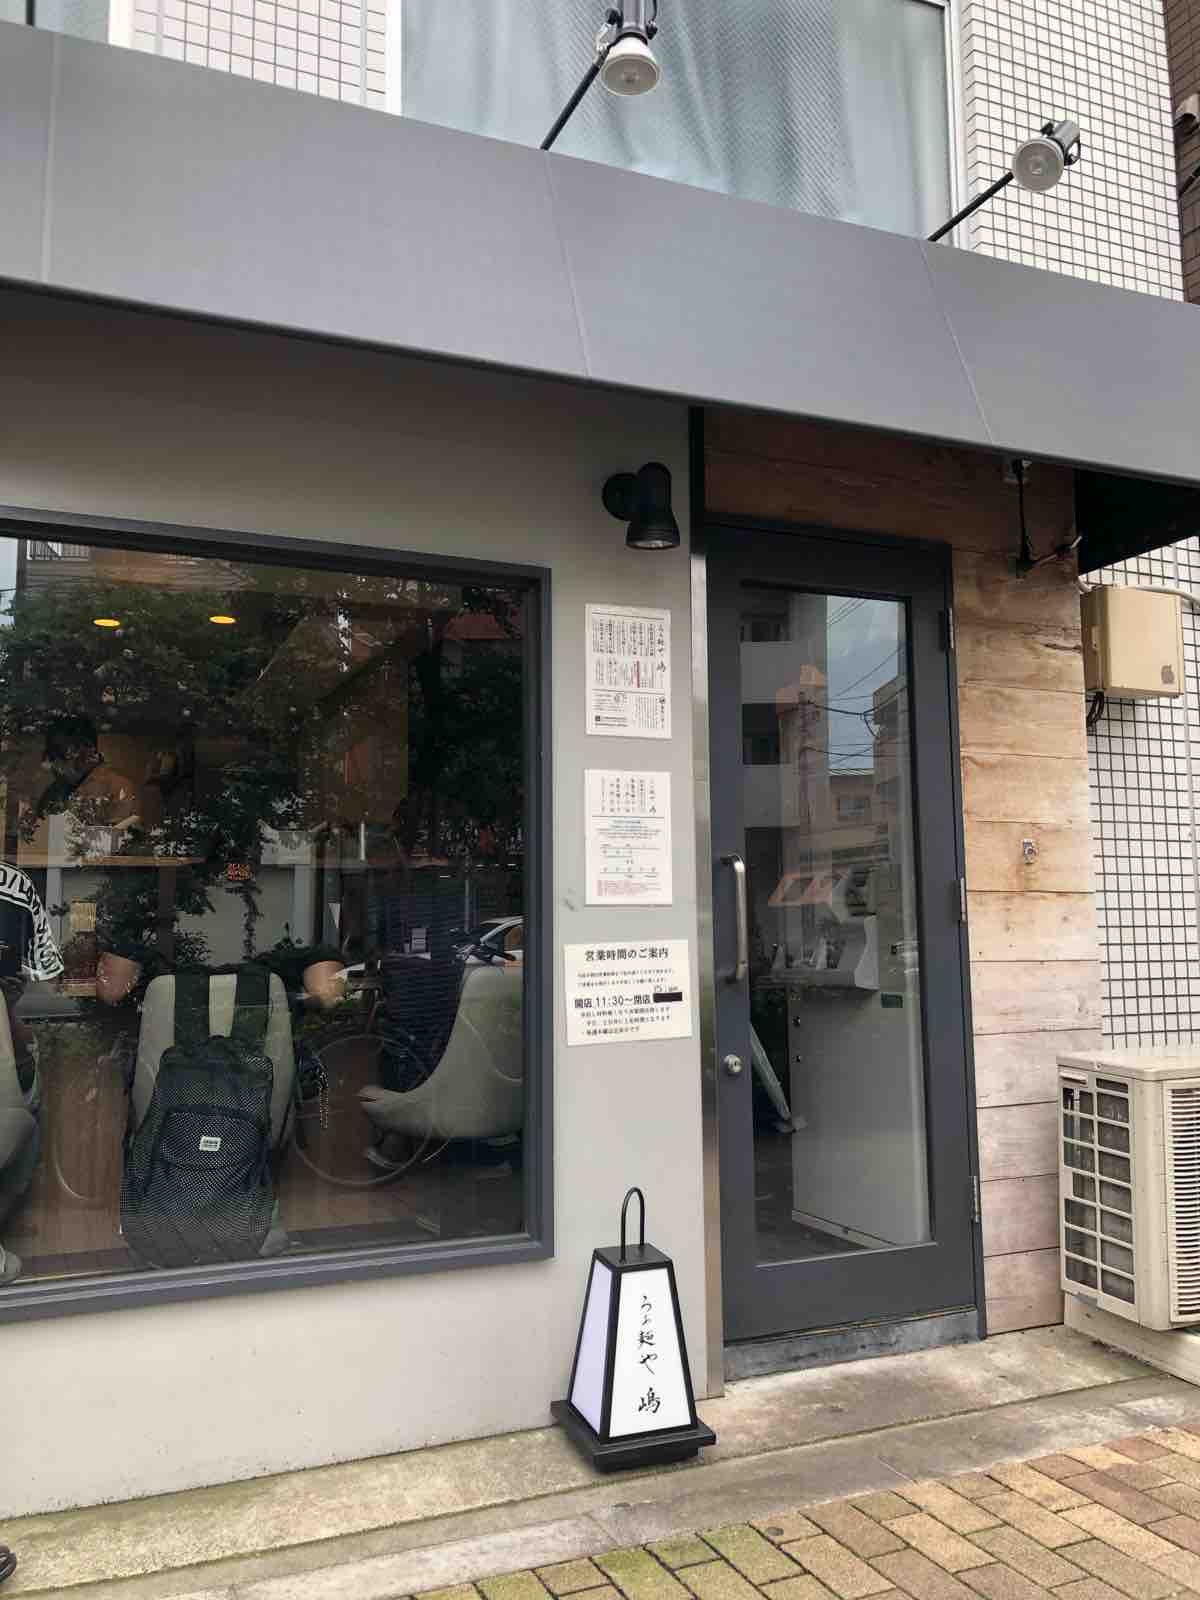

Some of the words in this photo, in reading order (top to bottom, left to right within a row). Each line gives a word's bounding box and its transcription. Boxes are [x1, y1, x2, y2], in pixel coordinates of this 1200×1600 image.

[584, 946, 669, 961] 営業時間のご案内
[574, 998, 593, 1009] 開店
